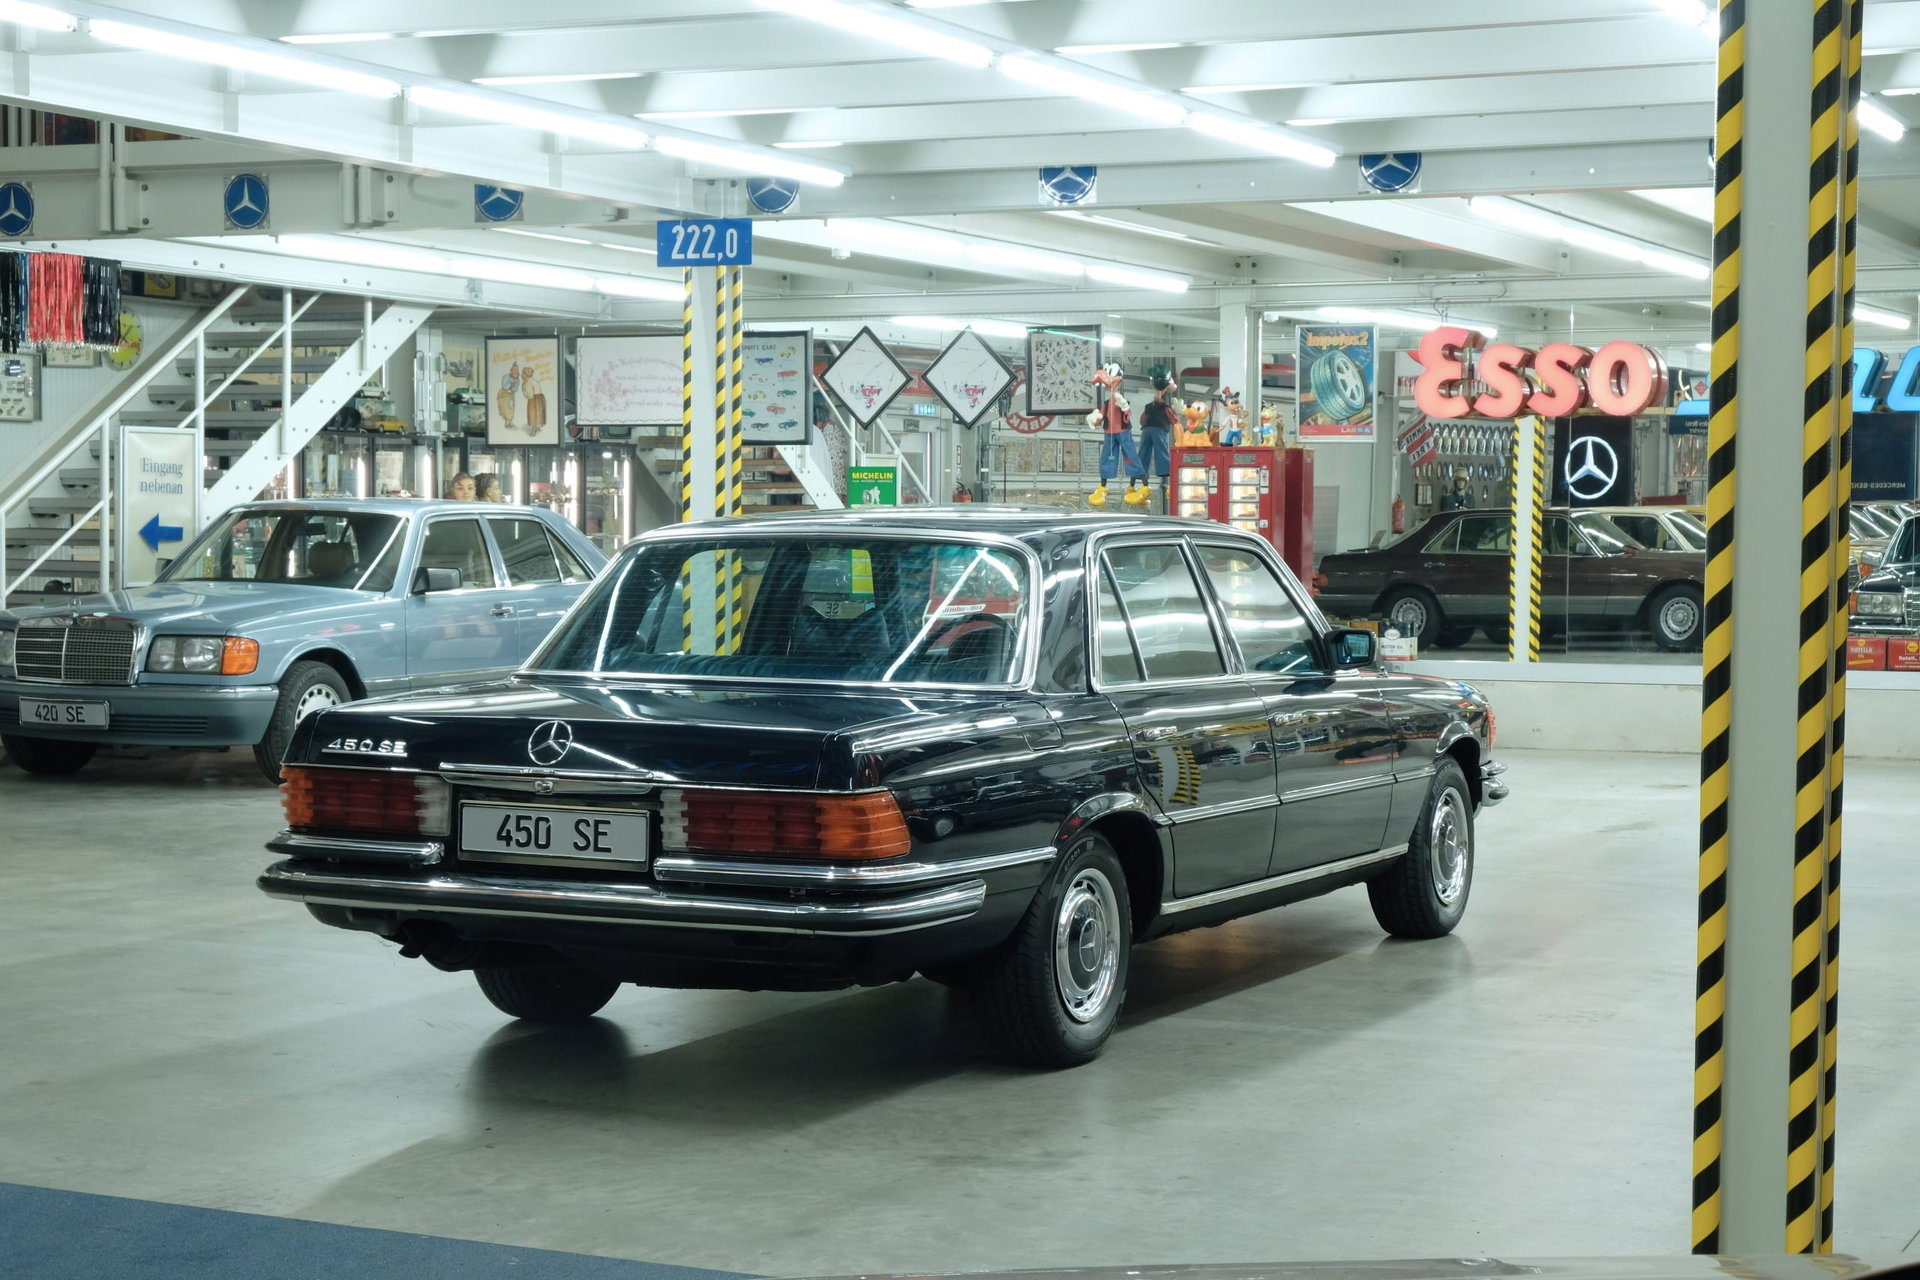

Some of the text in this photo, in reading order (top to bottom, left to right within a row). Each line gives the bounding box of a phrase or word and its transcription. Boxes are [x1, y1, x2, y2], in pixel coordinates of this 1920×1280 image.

[671, 224, 738, 262] 222,0
[142, 457, 184, 478] Eingang
[852, 472, 893, 480] MICHELIN
[140, 479, 184, 495] nebenan
[35, 704, 86, 723] 420 SE
[327, 738, 408, 753] 450 SE
[496, 814, 612, 853] 450 SE
